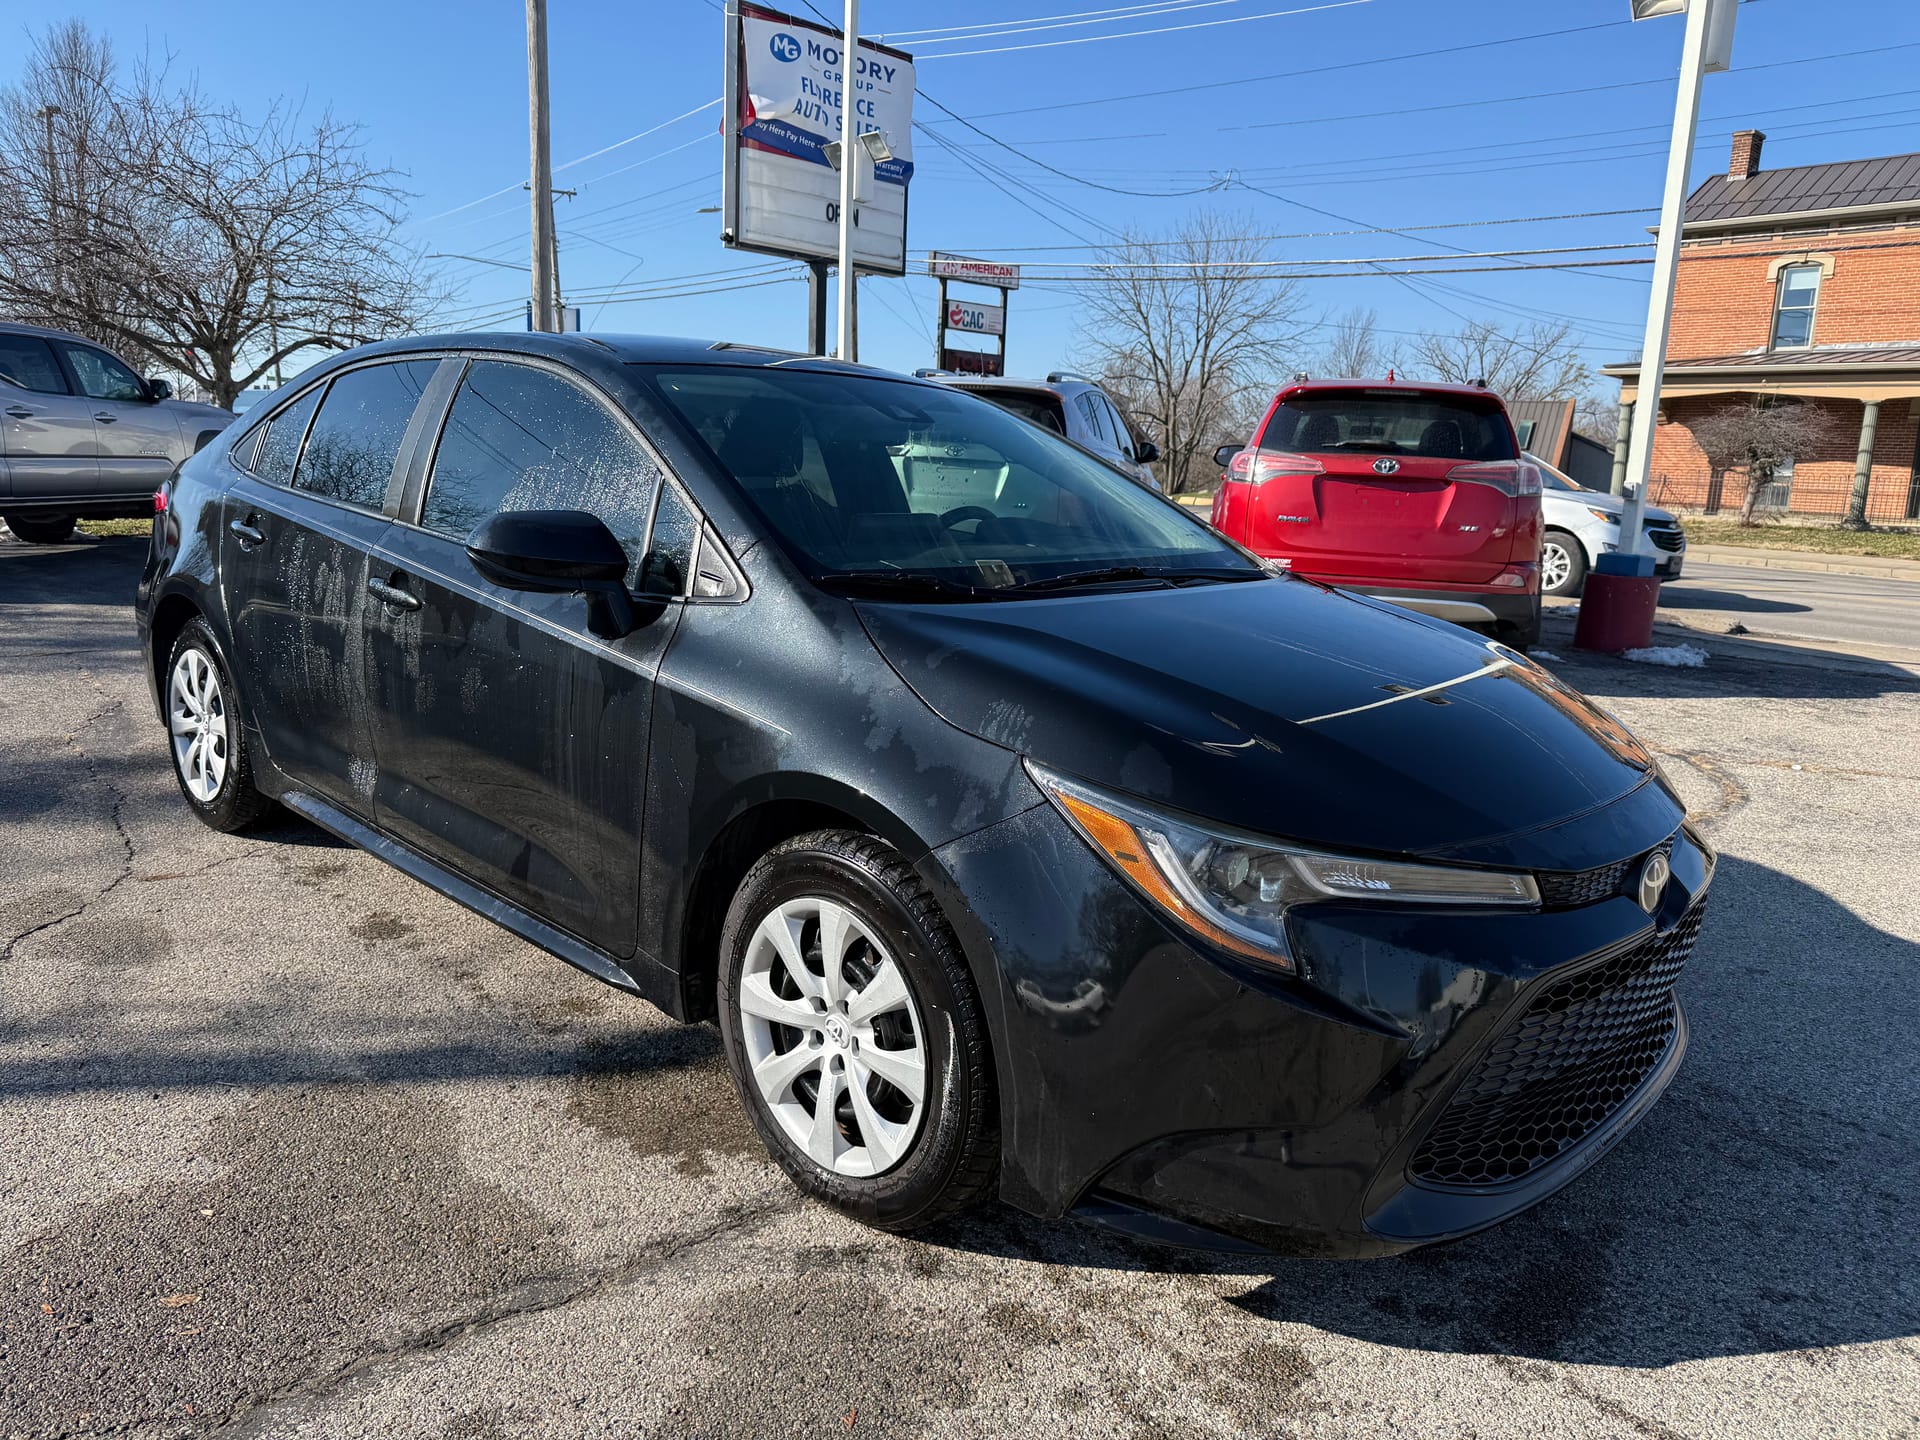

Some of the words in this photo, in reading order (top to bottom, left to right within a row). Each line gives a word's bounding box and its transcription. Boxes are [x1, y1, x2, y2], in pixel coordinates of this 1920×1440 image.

[773, 35, 799, 59] MG
[807, 39, 896, 83] MOORY
[823, 69, 874, 92] GRUP
[768, 123, 785, 137] Here
[786, 130, 799, 143] Pay
[799, 135, 816, 148] Here
[826, 202, 859, 227] OPN
[961, 263, 1012, 276] AMERICAN
[962, 310, 984, 329] CAC
